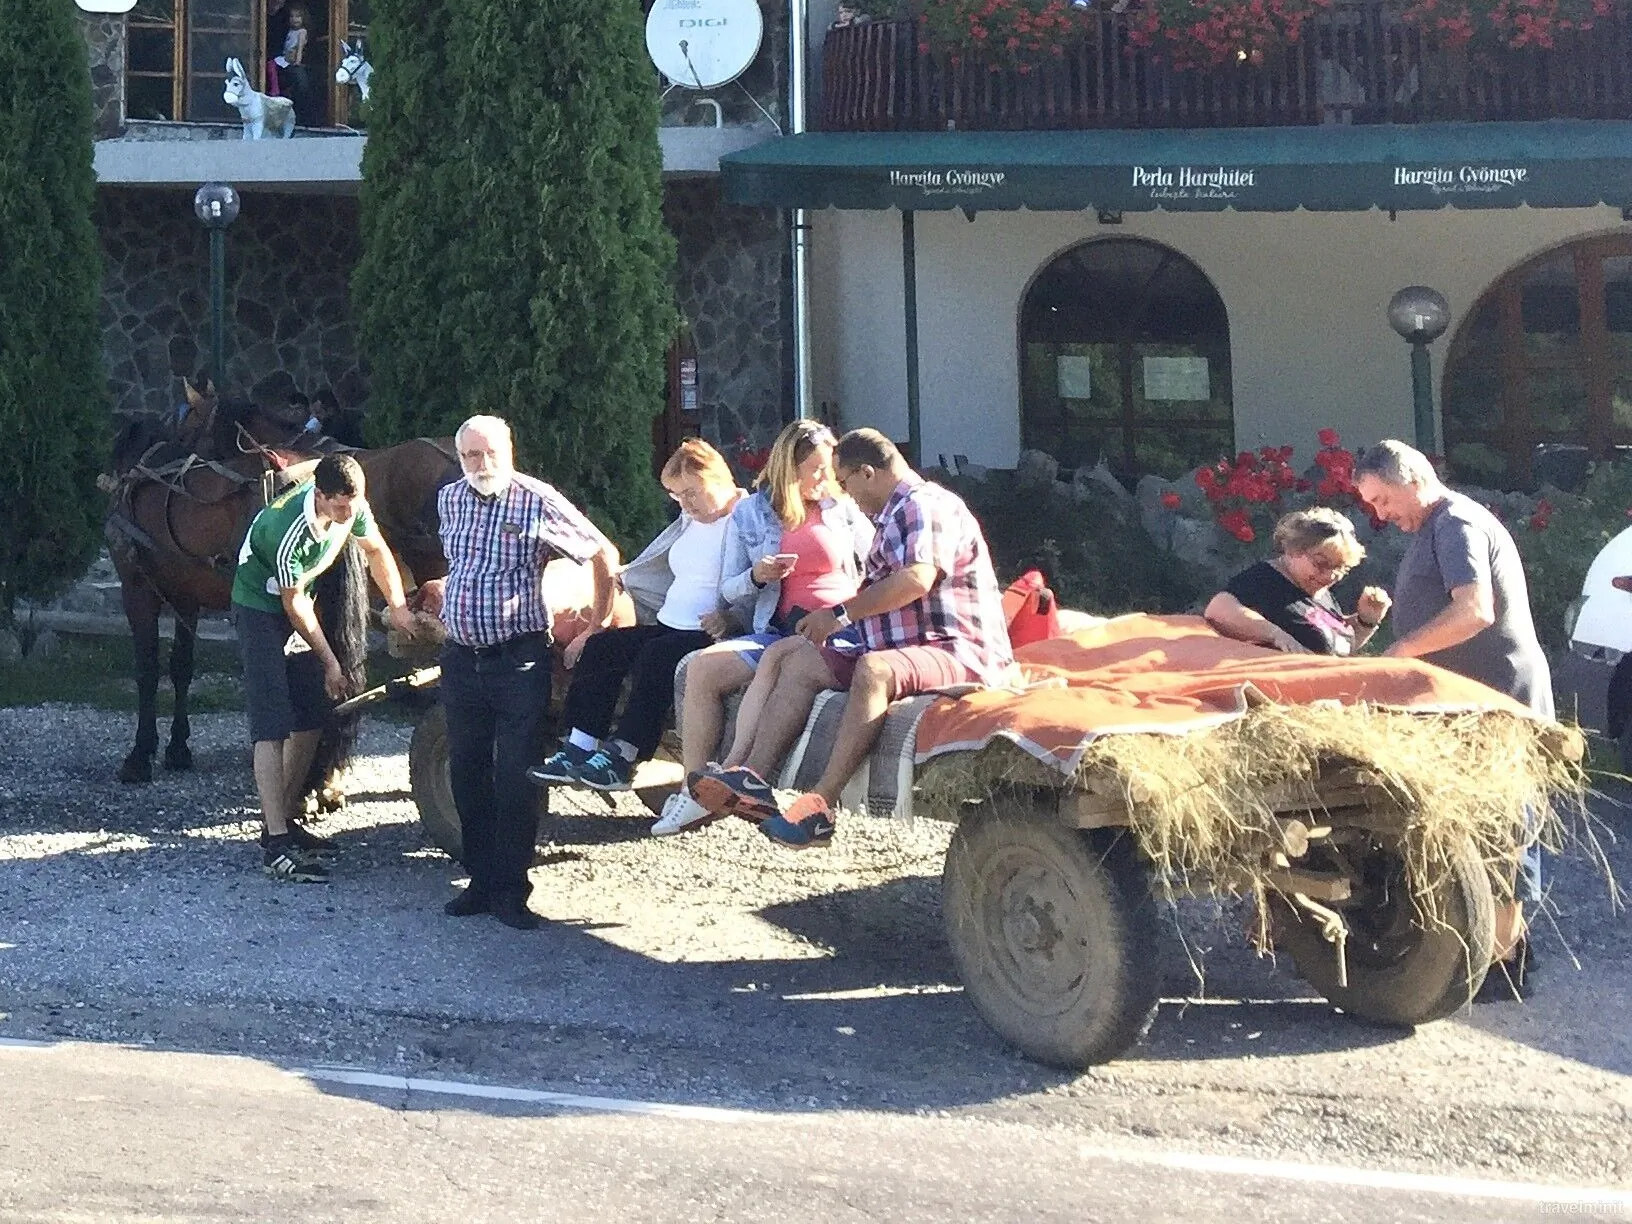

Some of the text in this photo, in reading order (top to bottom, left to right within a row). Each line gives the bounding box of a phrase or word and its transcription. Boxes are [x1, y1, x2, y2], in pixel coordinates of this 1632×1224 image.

[679, 18, 728, 28] DIGI
[889, 170, 942, 187] Hargita
[1132, 166, 1255, 190] Perla Harghitei
[1394, 166, 1528, 187] Hargita Gyöngye
